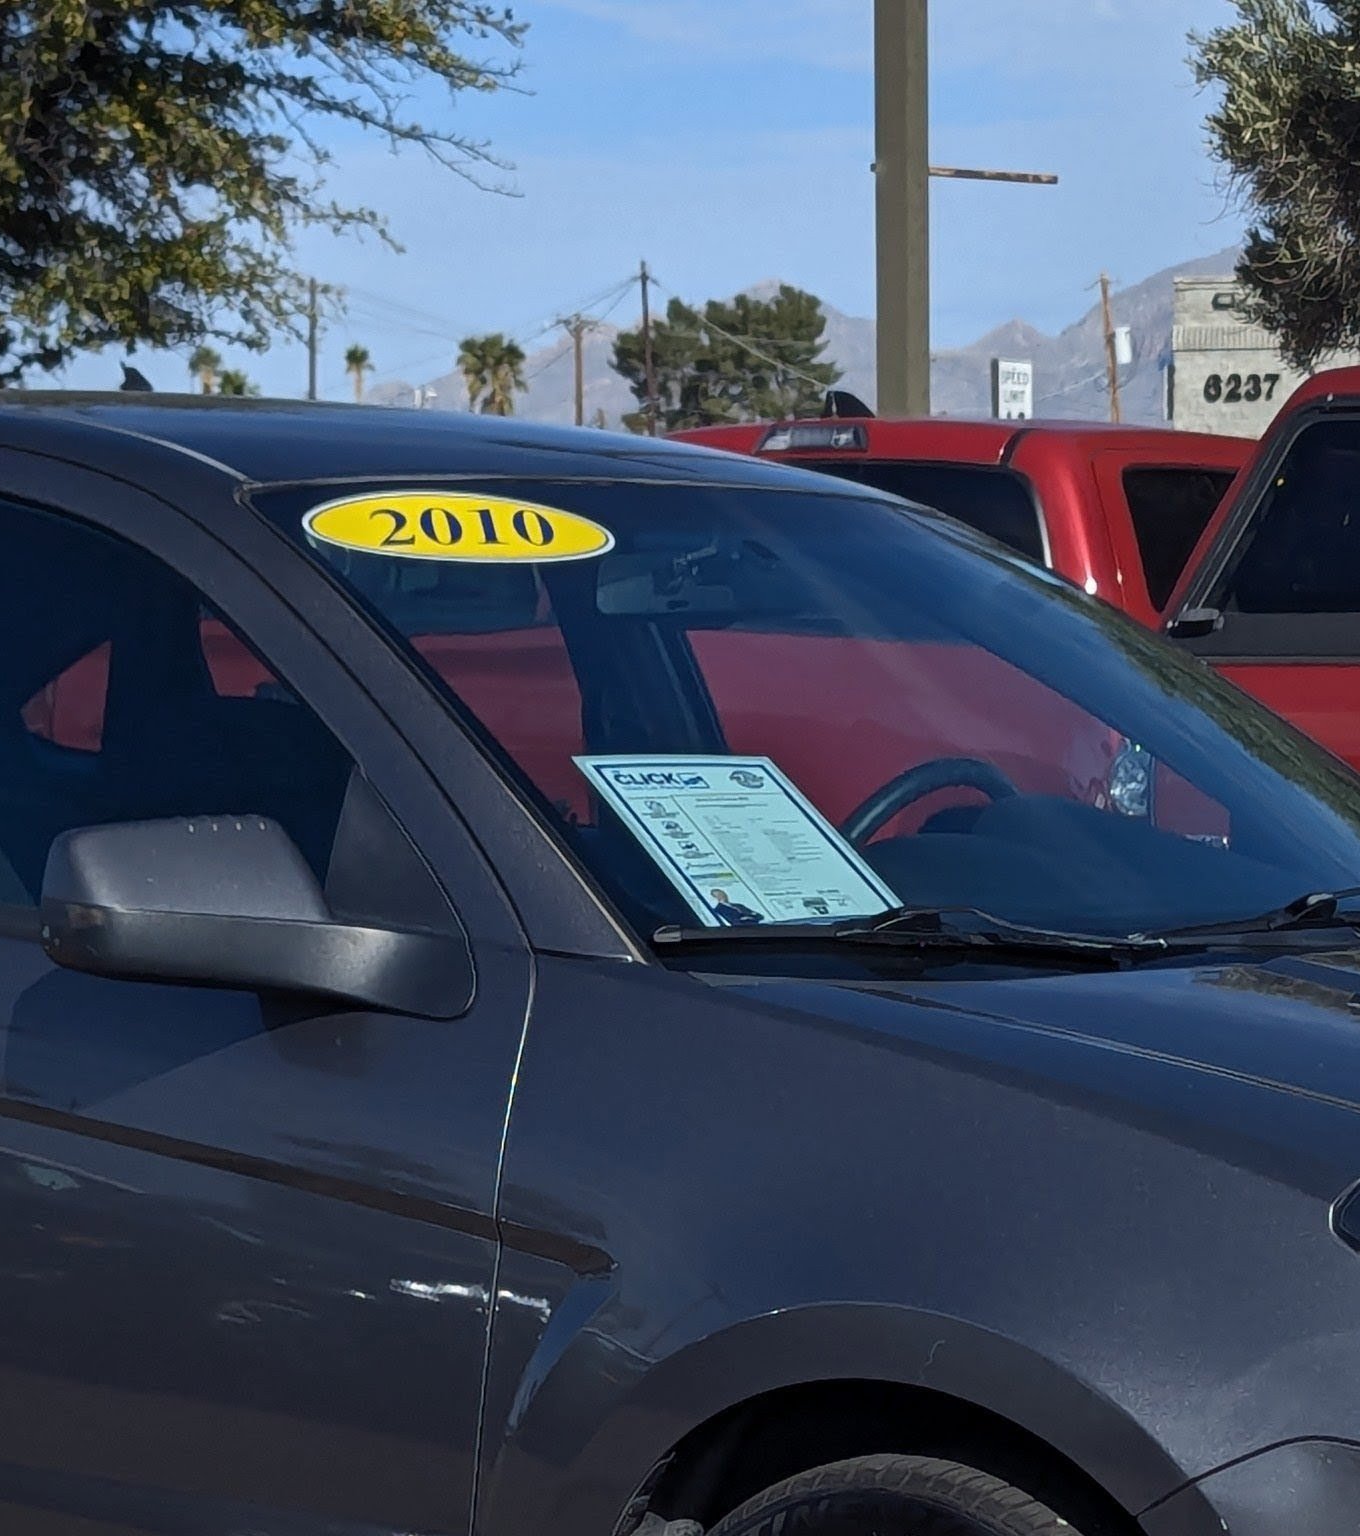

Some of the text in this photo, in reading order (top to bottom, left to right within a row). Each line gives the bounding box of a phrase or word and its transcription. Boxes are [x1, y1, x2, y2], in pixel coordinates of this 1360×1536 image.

[1203, 373, 1280, 403] 6237
[369, 507, 554, 547] 2010
[613, 772, 682, 786] CLICK
